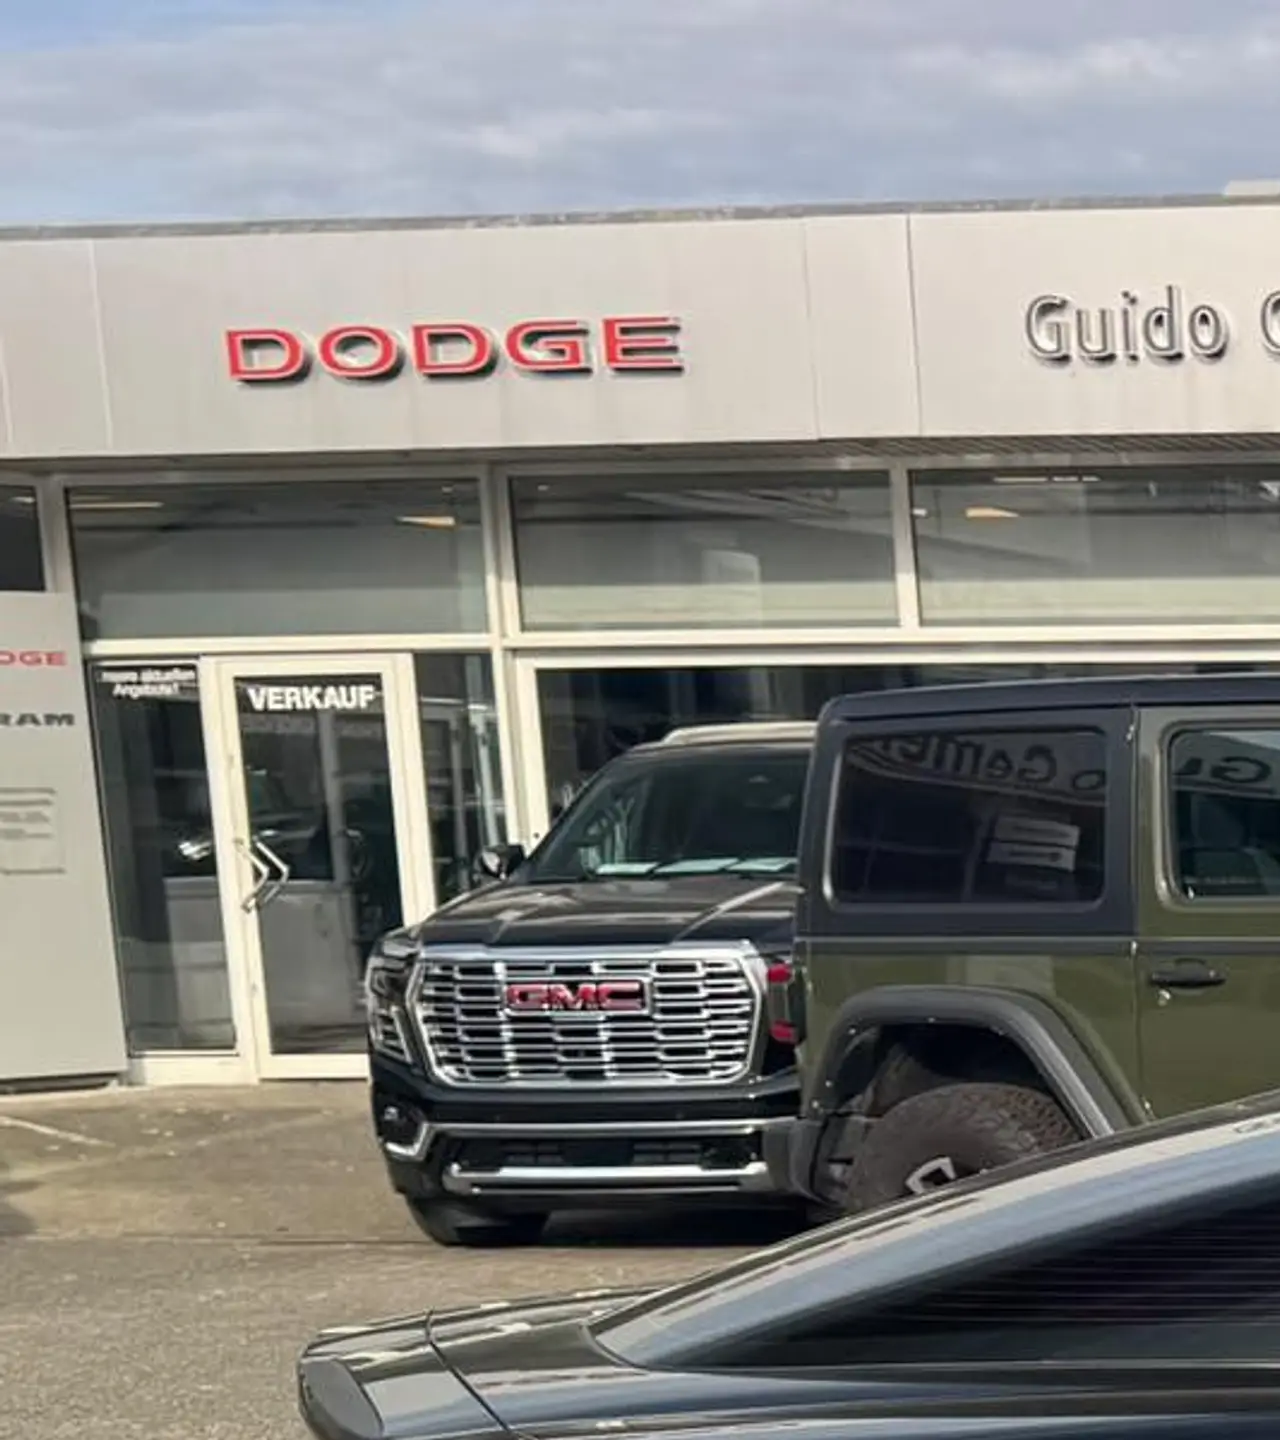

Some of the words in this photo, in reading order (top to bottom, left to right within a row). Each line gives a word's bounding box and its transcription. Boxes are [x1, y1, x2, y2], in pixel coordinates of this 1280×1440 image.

[1025, 285, 1232, 361] Guido
[225, 316, 682, 383] DODGE
[247, 684, 378, 712] VERKAUF
[506, 982, 643, 1011] GMC
